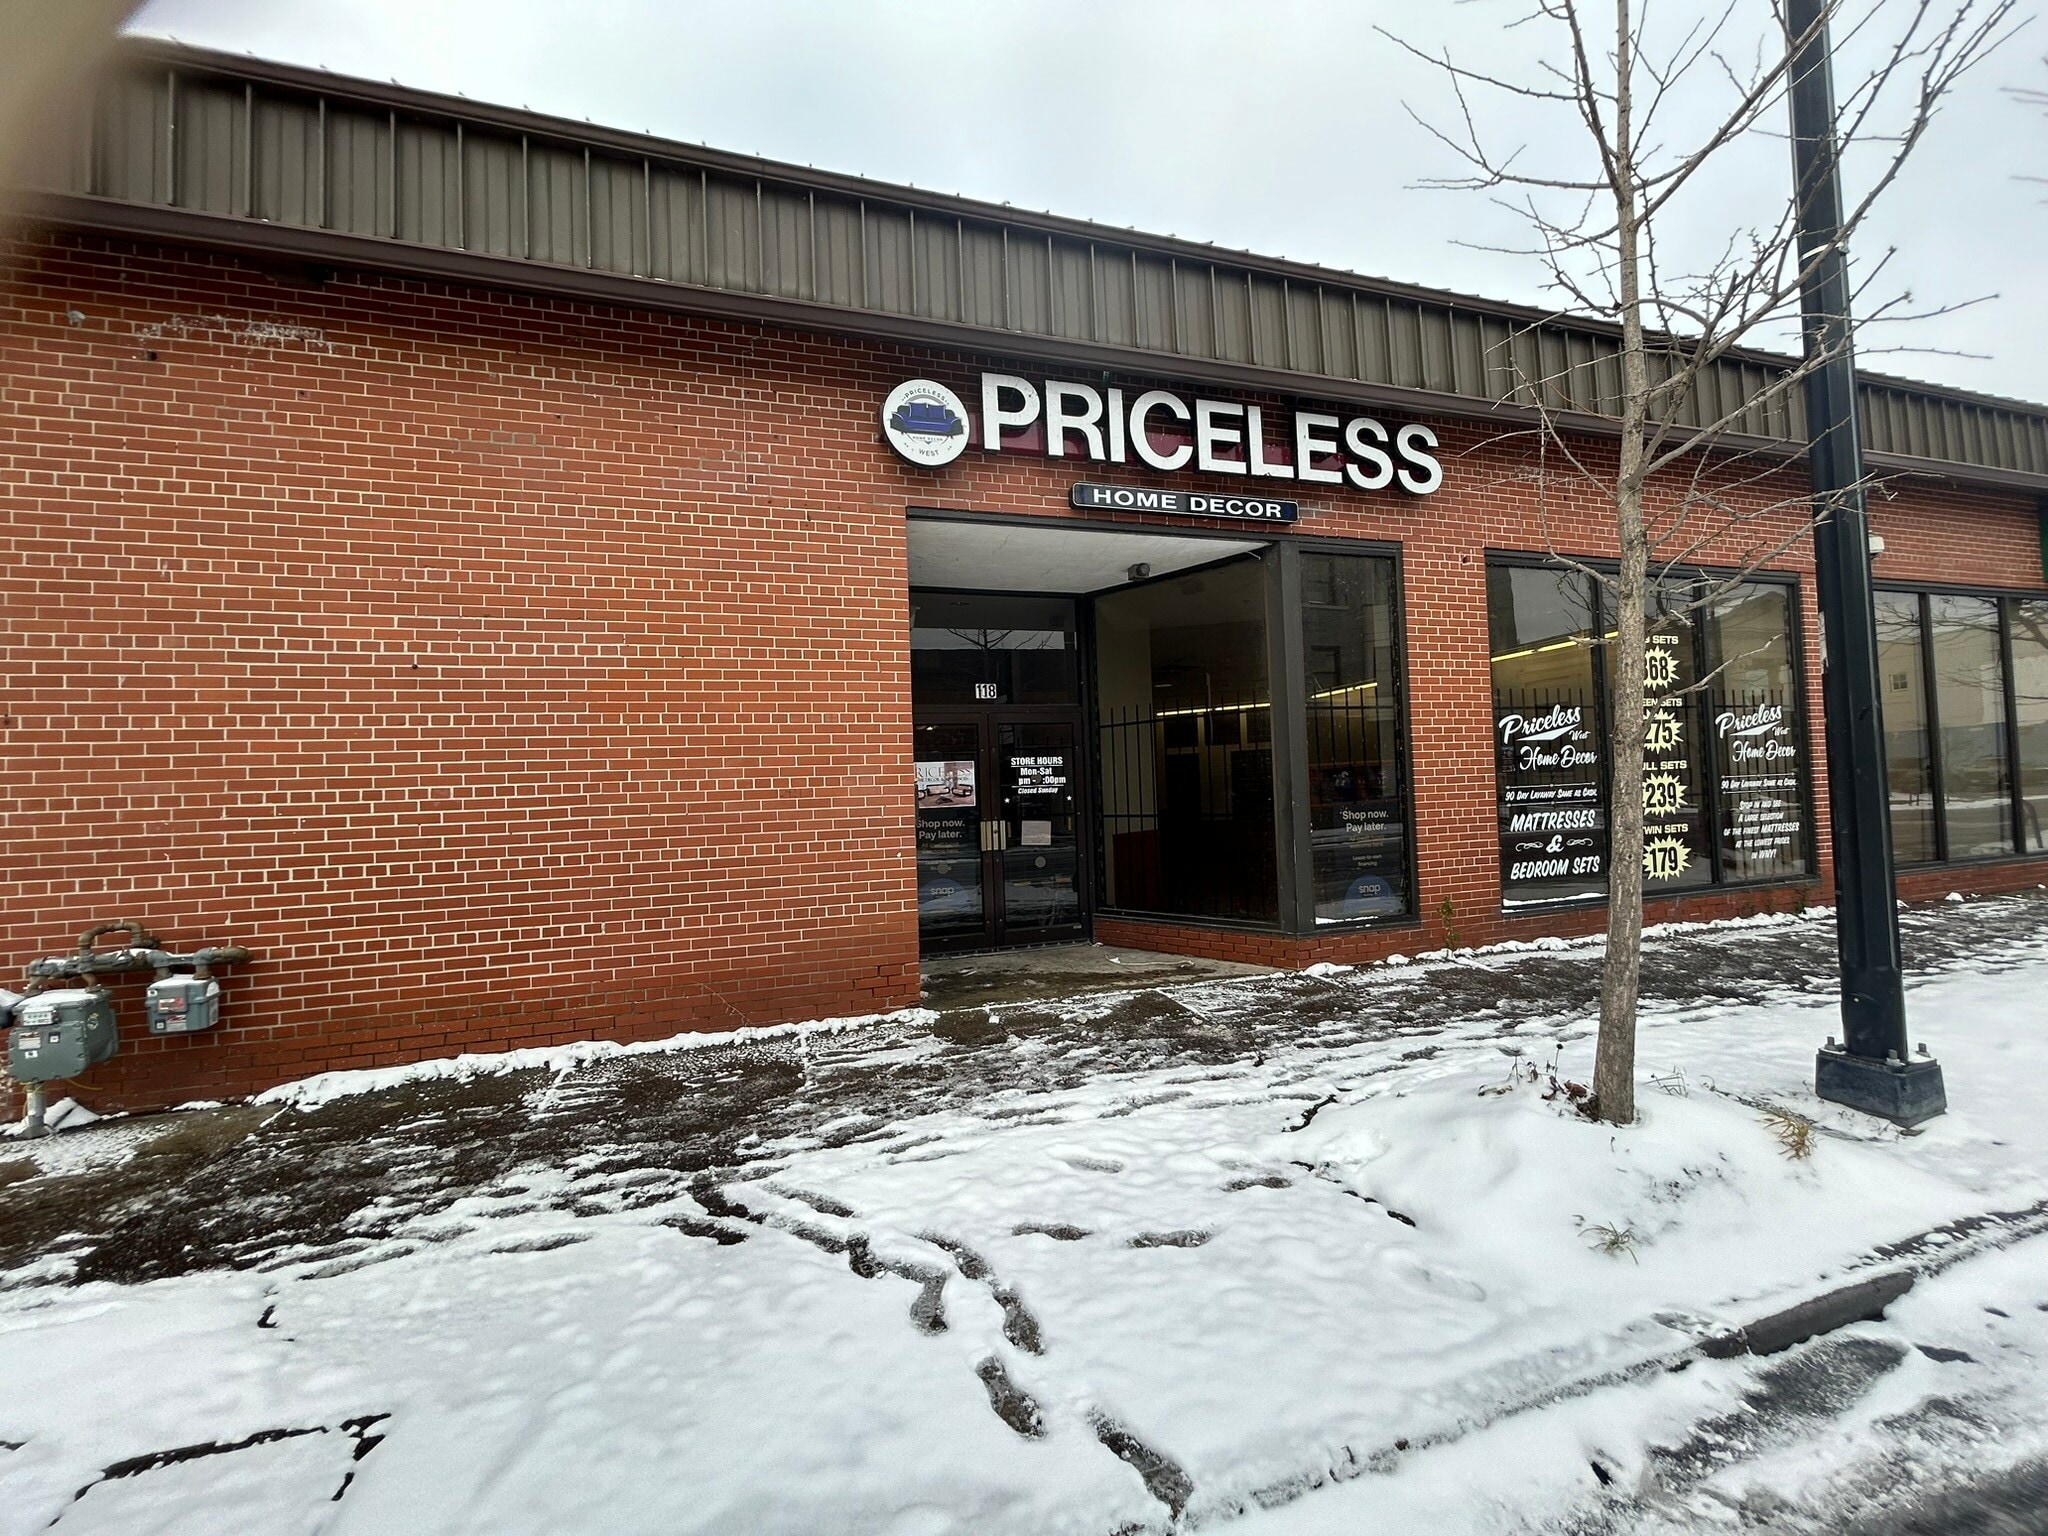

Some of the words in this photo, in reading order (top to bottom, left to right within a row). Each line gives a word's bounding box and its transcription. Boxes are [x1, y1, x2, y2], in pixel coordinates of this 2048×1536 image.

[905, 388, 945, 401] PRICELESS
[981, 372, 1443, 495] PRICELESS
[919, 448, 939, 457] WEST
[1093, 488, 1177, 510] HOME
[1190, 497, 1281, 518] DECOR
[1652, 635, 1679, 645] SETS
[976, 684, 997, 699] 118
[1499, 704, 1581, 744] Priceless
[1715, 703, 1782, 739] Priceless
[1568, 730, 1591, 741] West
[1732, 740, 1765, 762] Home
[1765, 739, 1796, 760] Decor
[1011, 757, 1035, 766] STORE
[1037, 756, 1063, 765] HOURS
[1520, 745, 1560, 770] Home
[1560, 745, 1597, 768] Decor
[1660, 760, 1687, 770] SETS
[1020, 767, 1052, 776] Mon-Sat
[1505, 791, 1515, 801] 90
[1645, 782, 1677, 808] 239
[1342, 810, 1366, 821] Shop
[1367, 810, 1389, 819] now.
[1510, 809, 1596, 832] MATTRESSES
[917, 819, 940, 830] Shop
[942, 819, 965, 828] now.
[1346, 823, 1362, 834] Pay
[1364, 822, 1386, 831] later.
[1664, 824, 1689, 833] SETS
[1761, 822, 1800, 833] MATTRESSES
[919, 830, 937, 841] Pay
[938, 829, 962, 839] later.
[1546, 834, 1565, 853] &
[1649, 846, 1678, 873] 179
[1510, 858, 1569, 880] BEDROOM
[1572, 855, 1600, 874] SETS
[931, 887, 955, 898] snap
[1358, 882, 1381, 895] snap
